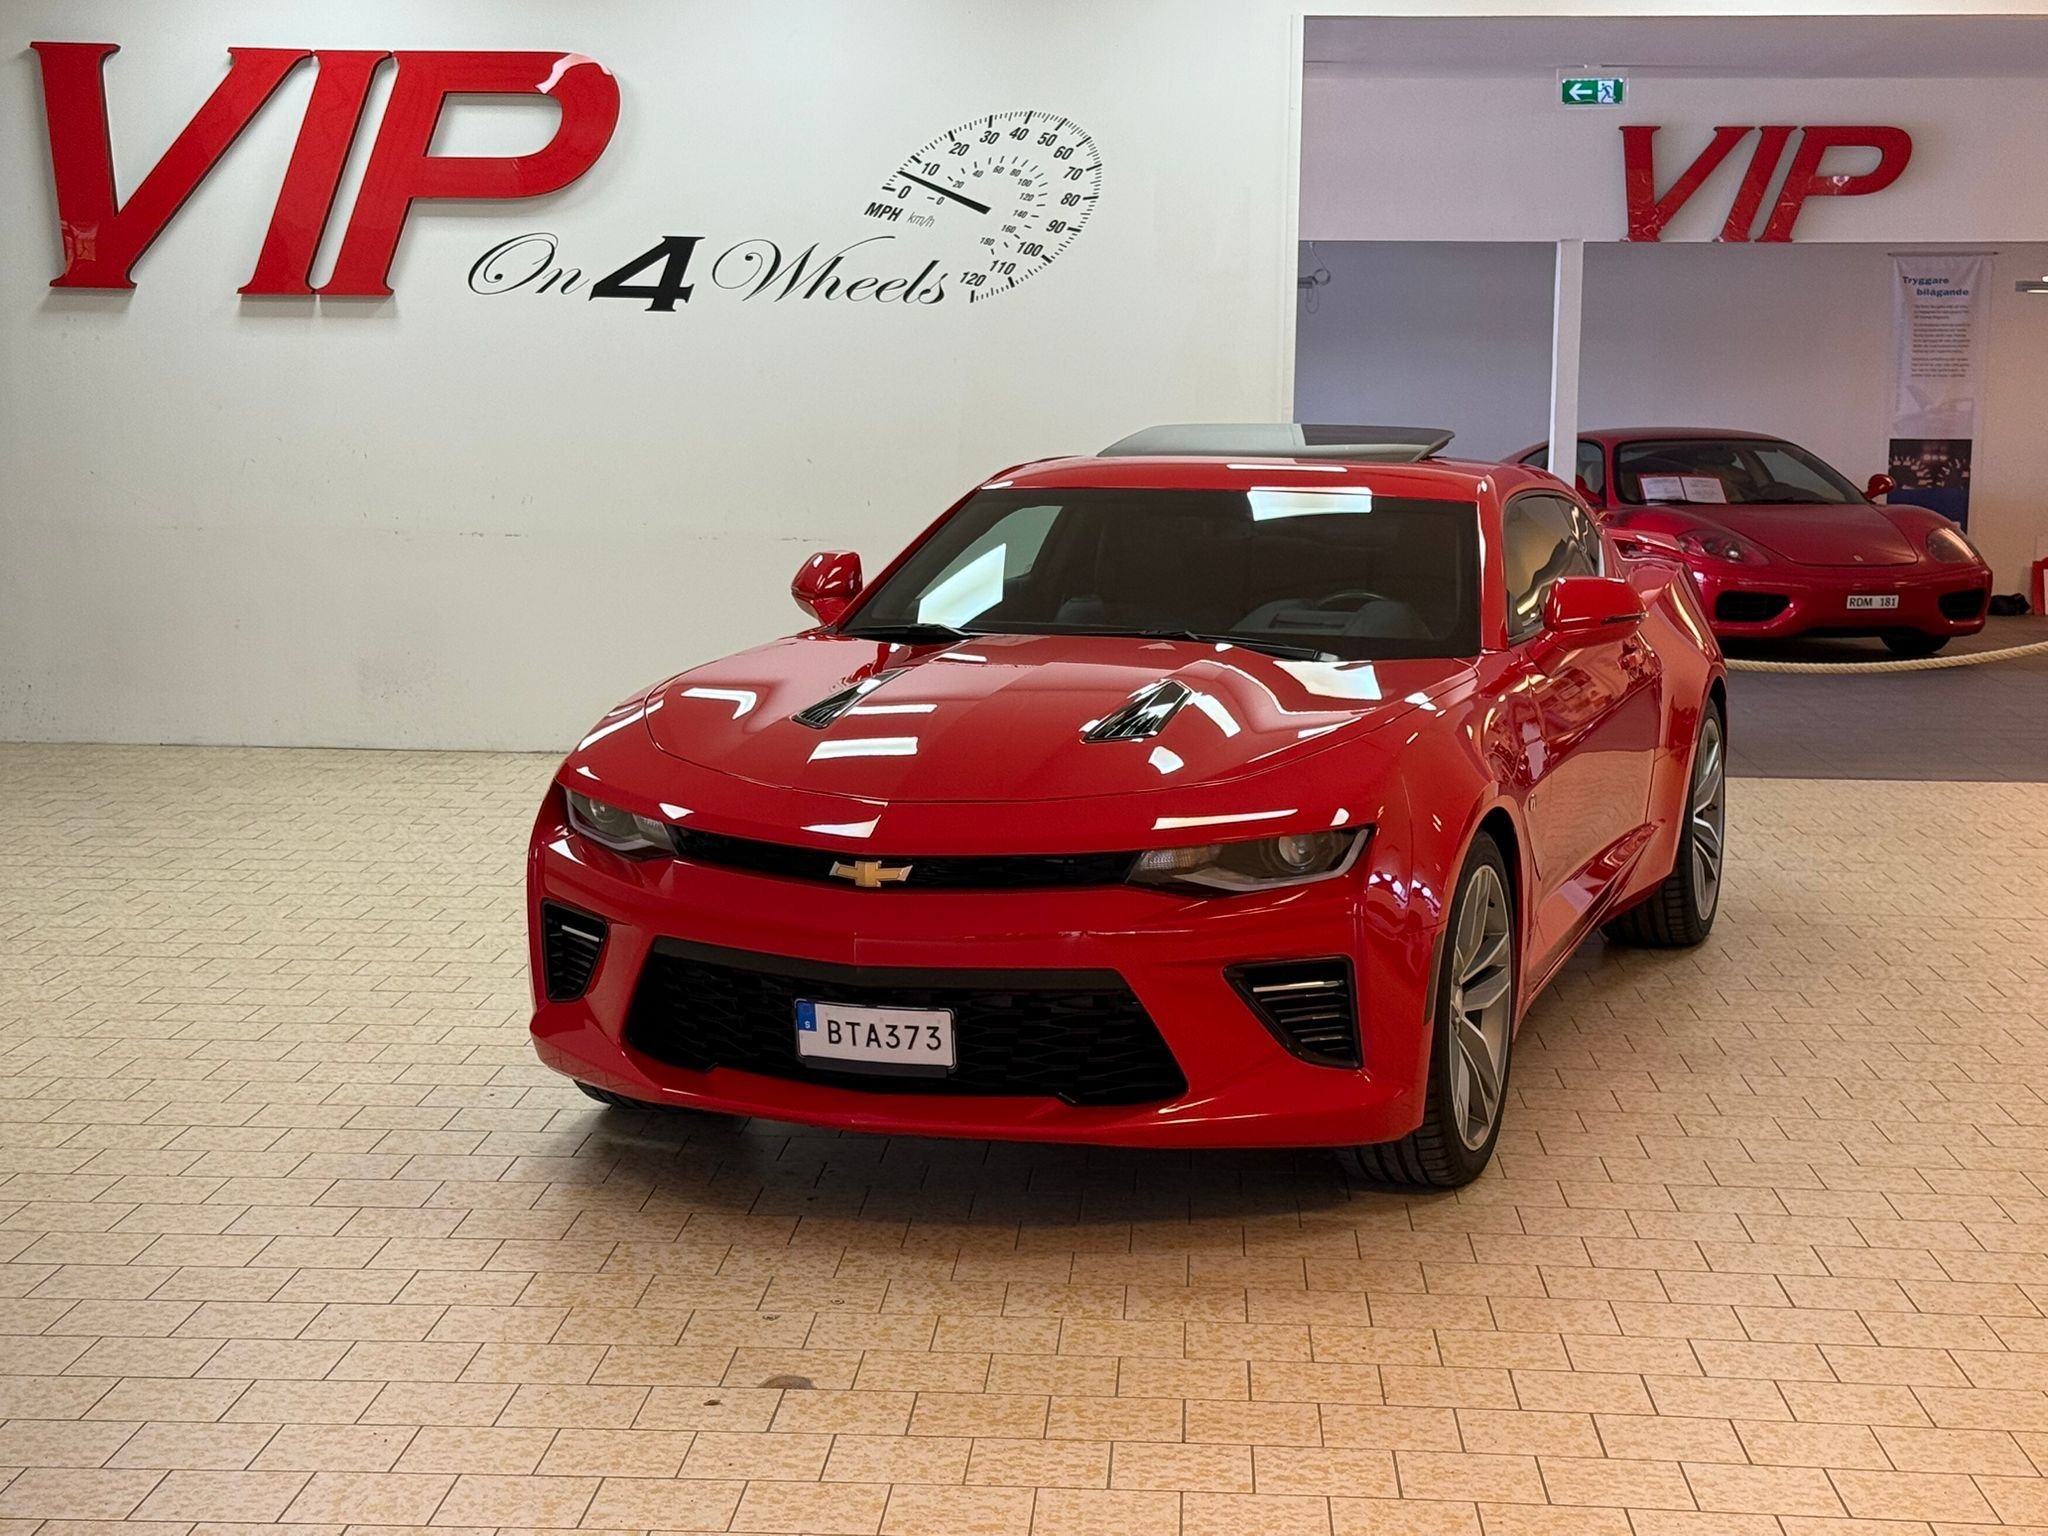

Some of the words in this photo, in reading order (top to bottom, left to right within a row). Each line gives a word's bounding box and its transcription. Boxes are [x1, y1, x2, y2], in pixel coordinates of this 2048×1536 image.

[979, 130, 1000, 144] 30
[1009, 127, 1029, 141] 40
[1037, 132, 1058, 147] 50
[948, 142, 970, 156] 20
[1053, 146, 1074, 160] 60
[30, 41, 621, 295] VIP
[920, 162, 940, 176] 10
[1063, 166, 1083, 181] 70
[1618, 126, 1913, 242] VIP
[897, 185, 912, 199] 0
[936, 196, 945, 205] 0
[1060, 193, 1081, 207] 80
[864, 202, 903, 222] MPH
[906, 211, 936, 228] km/h
[1046, 220, 1067, 234] 90
[1016, 241, 1044, 257] 100
[468, 232, 590, 295] On
[588, 236, 706, 312] 4
[712, 236, 949, 304] Wheels
[990, 260, 1016, 275] 110
[959, 272, 987, 287] 120
[1902, 276, 1950, 286] Tryggare
[1880, 597, 1897, 607] 181
[803, 1020, 811, 1029] S
[827, 1019, 942, 1051] BTA373
